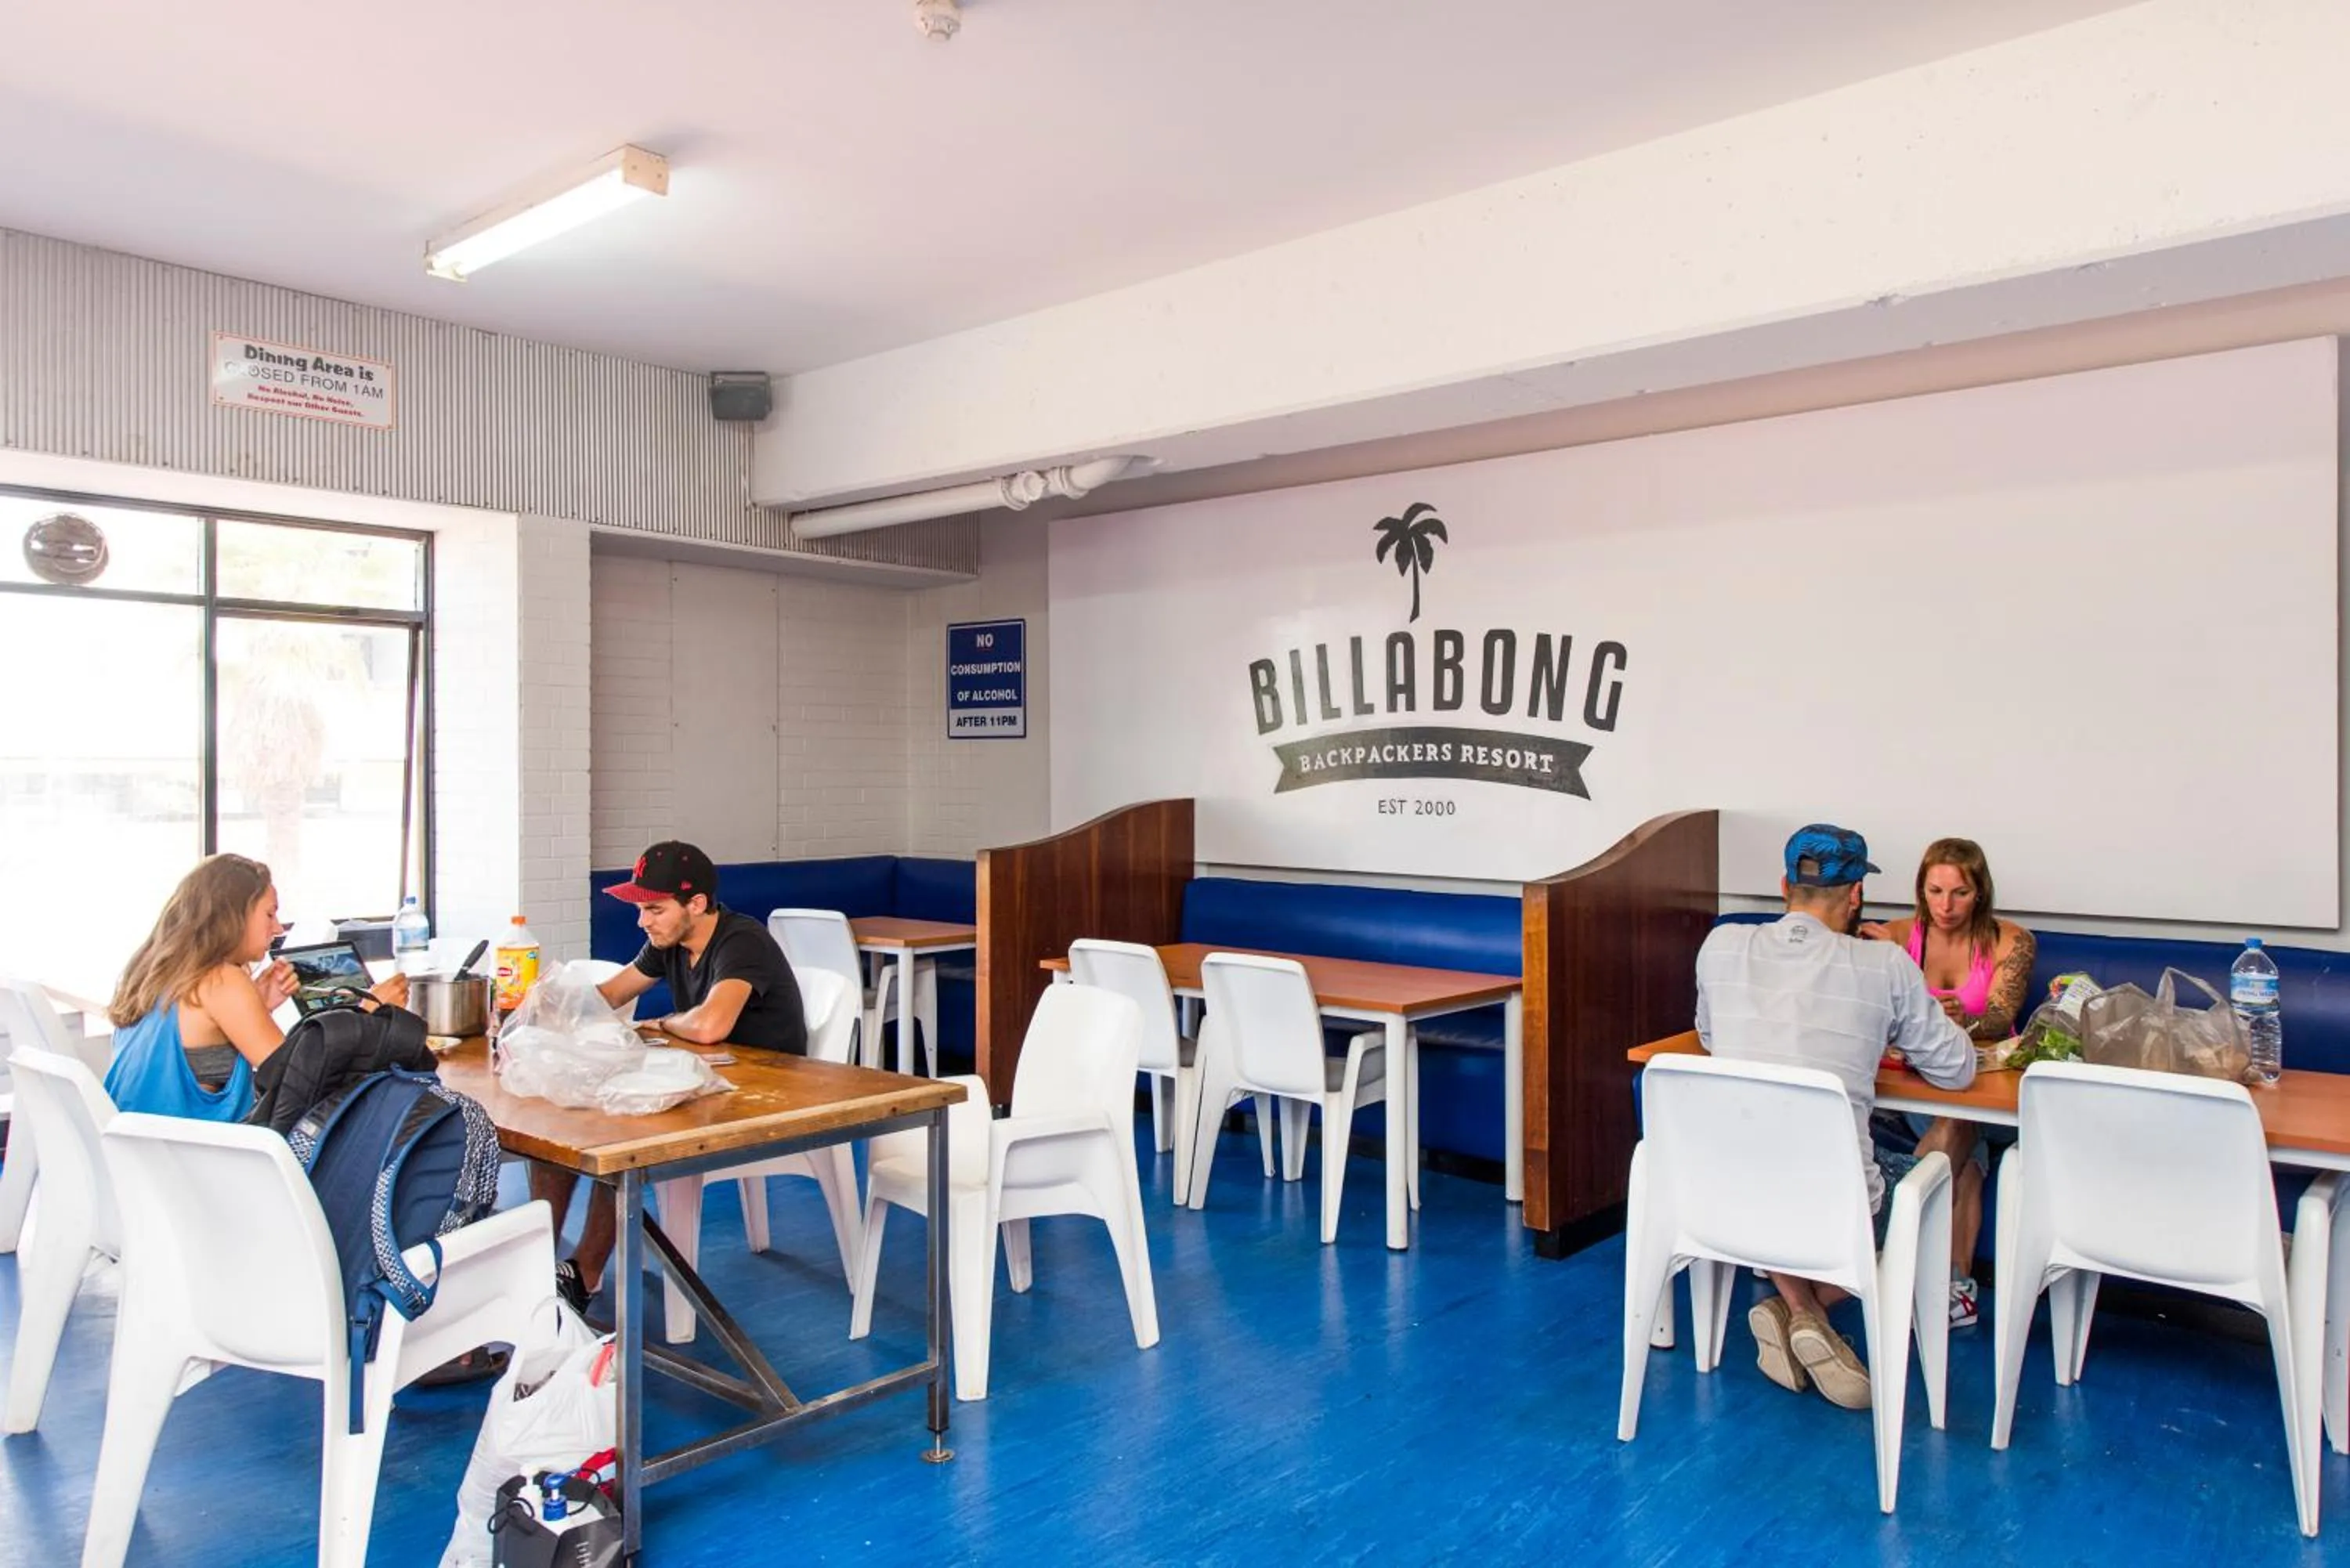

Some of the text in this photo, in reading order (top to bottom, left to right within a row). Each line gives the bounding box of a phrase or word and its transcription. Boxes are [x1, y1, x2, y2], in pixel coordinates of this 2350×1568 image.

[244, 344, 374, 381] Dining Area is
[301, 374, 347, 393] FROM
[354, 385, 383, 399] 1AM
[976, 634, 993, 648] NO
[950, 662, 1021, 675] CONSUMPTION
[1249, 629, 1627, 735] BILLABONG
[957, 688, 1018, 702] OF ALCOHOL
[956, 714, 1017, 728] AFTER 11PM
[1299, 743, 1554, 773] BACKPACKERS RESORT
[1378, 799, 1456, 816] EST 2000
